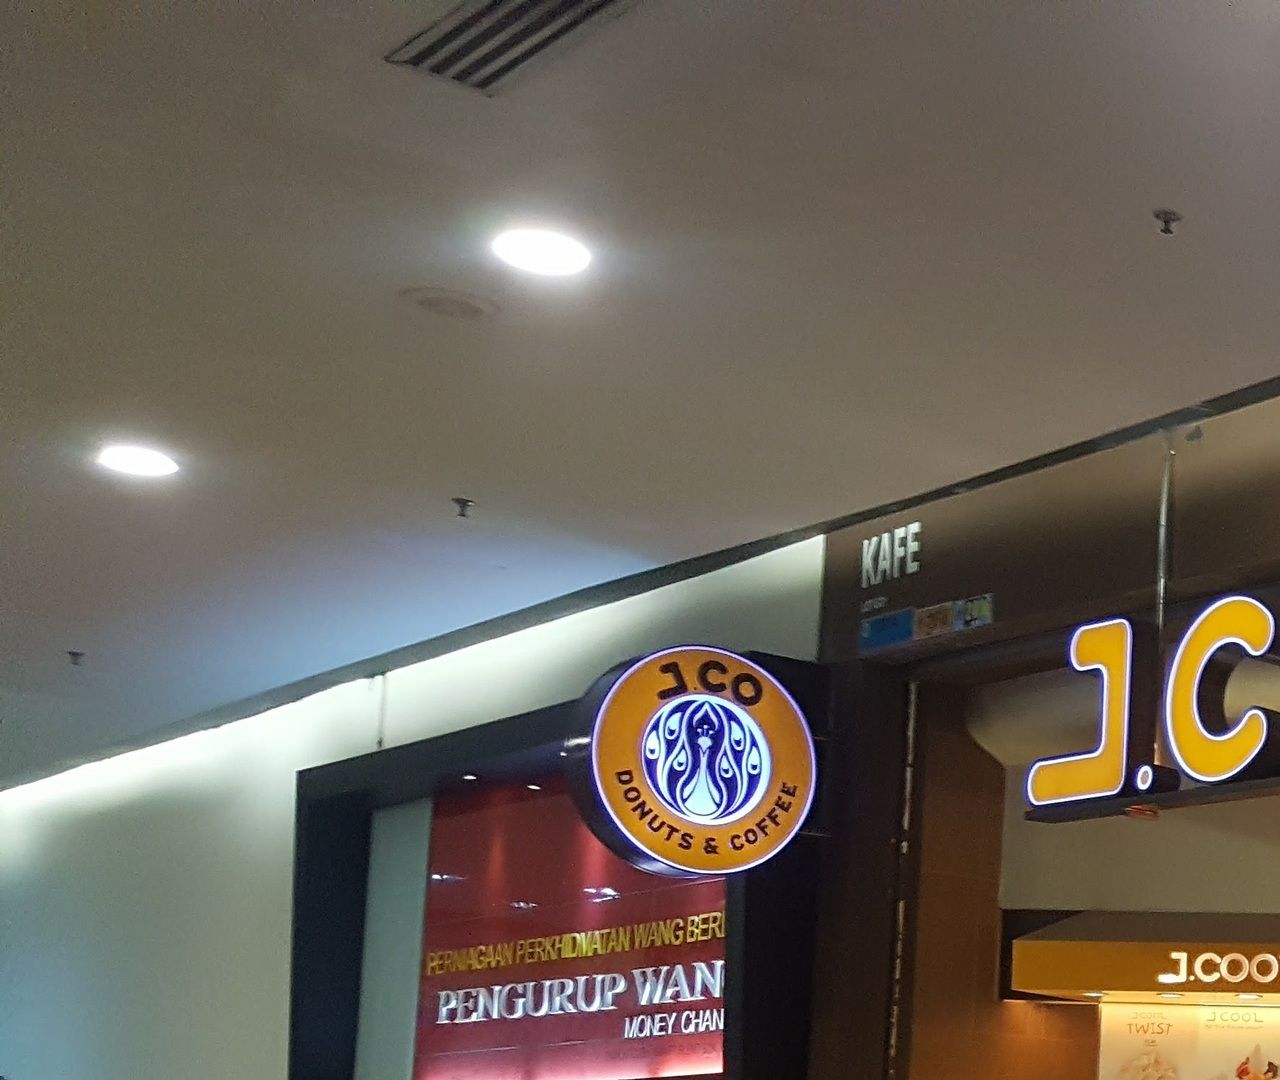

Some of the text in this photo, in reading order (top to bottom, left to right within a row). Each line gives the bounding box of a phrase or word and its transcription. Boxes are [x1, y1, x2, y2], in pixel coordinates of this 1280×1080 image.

[861, 521, 923, 589] KAFE
[614, 769, 799, 855] DONUTS & COFFEE
[631, 918, 684, 950] WANG
[436, 959, 725, 1024] PENGURUP WAN
[624, 1008, 725, 1039] MONEY CHAN
[1126, 1023, 1174, 1036] TWIST
